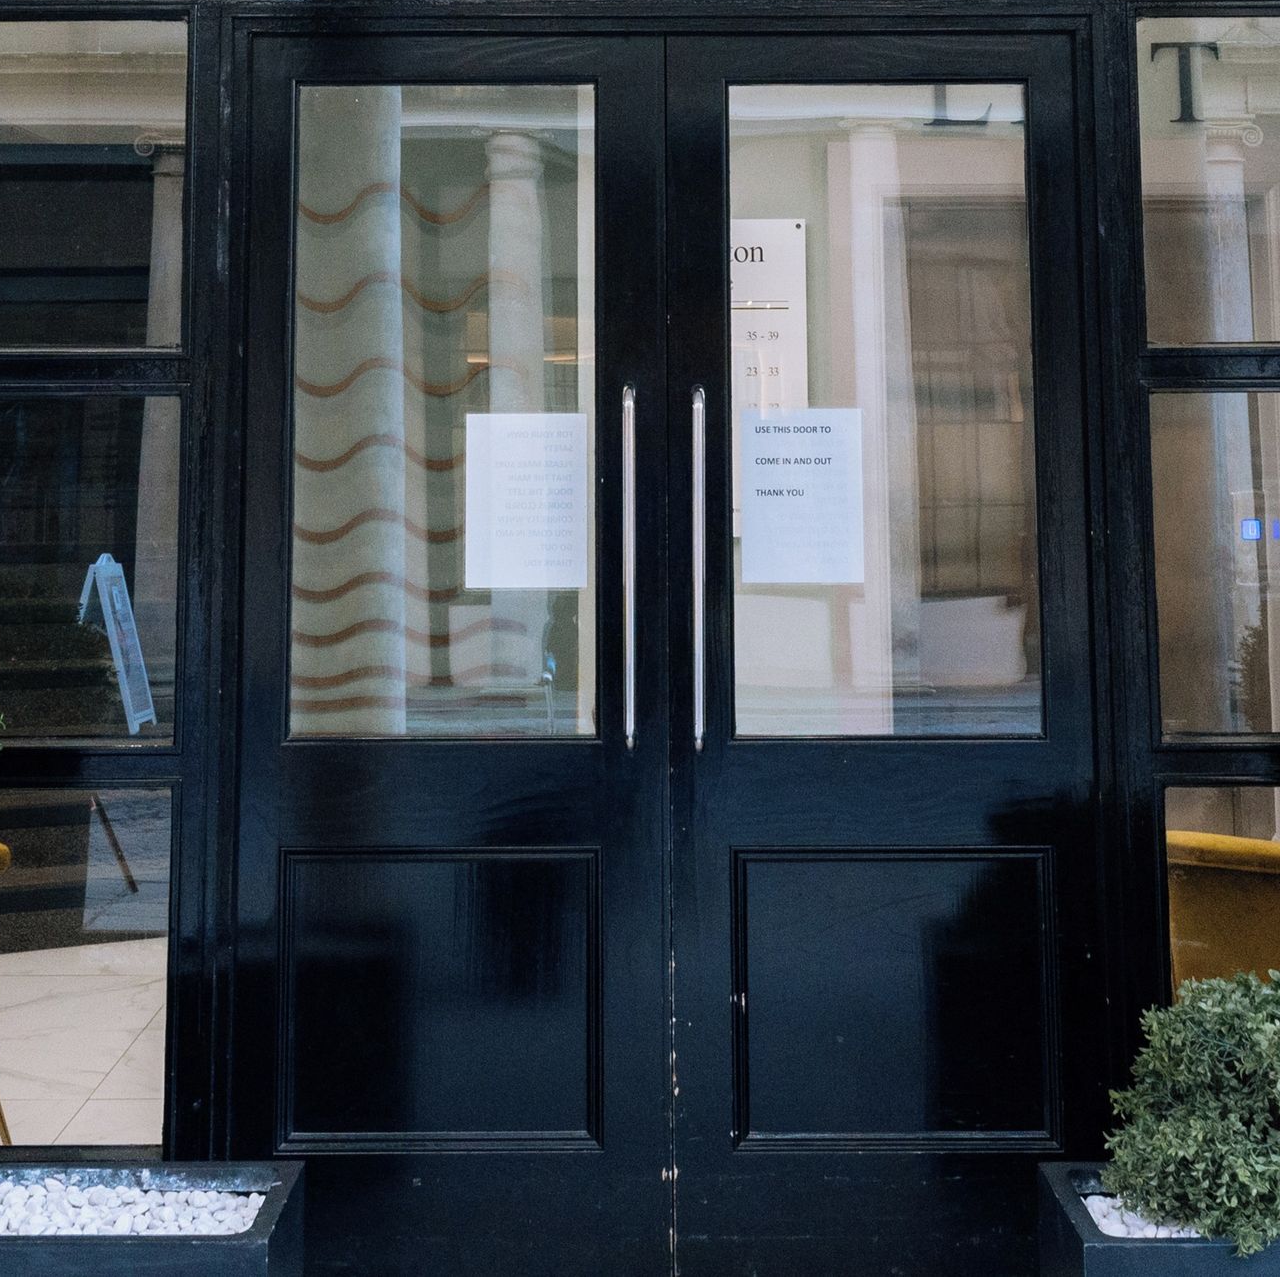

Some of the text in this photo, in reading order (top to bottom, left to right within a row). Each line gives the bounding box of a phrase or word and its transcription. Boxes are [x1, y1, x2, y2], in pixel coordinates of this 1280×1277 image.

[745, 331, 758, 341] 35
[767, 331, 780, 341] 39
[745, 366, 758, 376] 23
[768, 366, 780, 376] 33
[755, 457, 832, 465] COME IN AND OUT
[755, 489, 804, 497] THANK YOU
